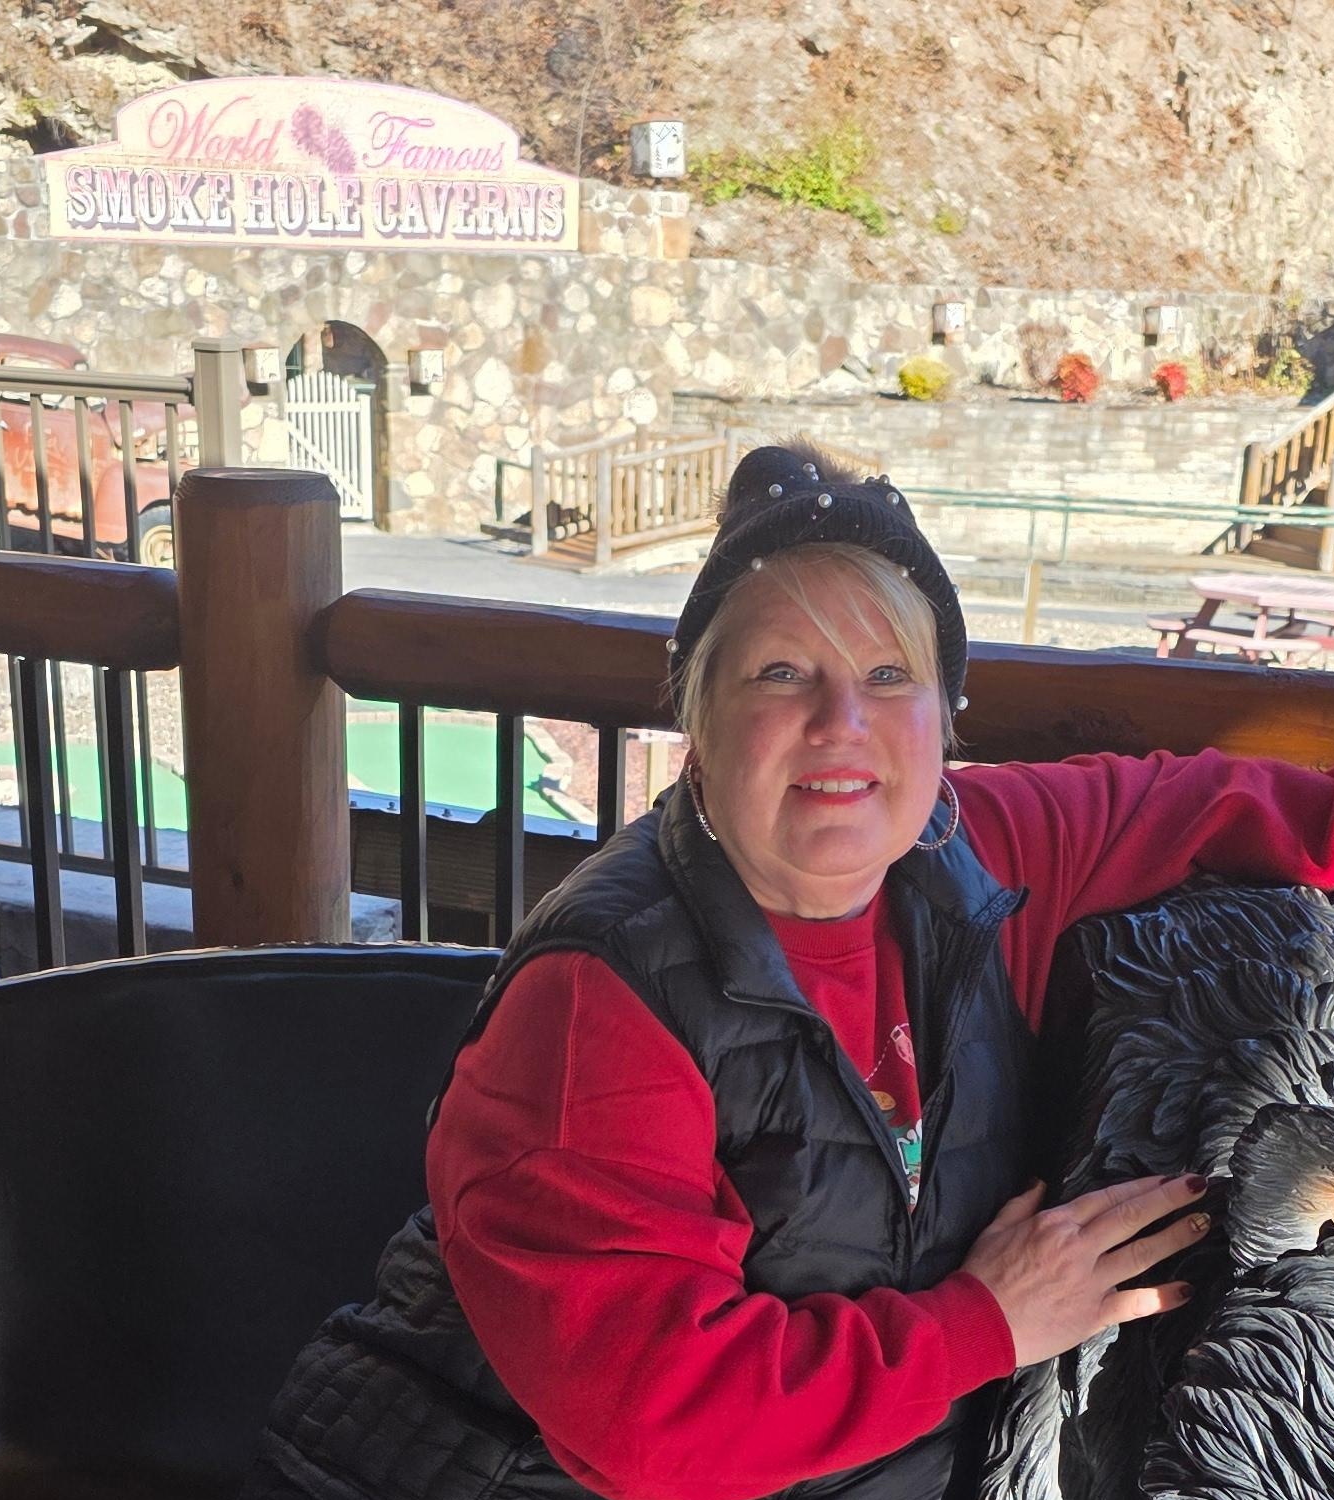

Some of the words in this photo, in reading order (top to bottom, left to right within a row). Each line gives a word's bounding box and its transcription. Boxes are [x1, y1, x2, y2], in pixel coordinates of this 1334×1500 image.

[148, 96, 285, 162] World
[362, 111, 506, 171] Famous
[66, 164, 235, 234] SMOKE
[242, 172, 364, 238] HOLE
[372, 178, 566, 241] CAVERNS
